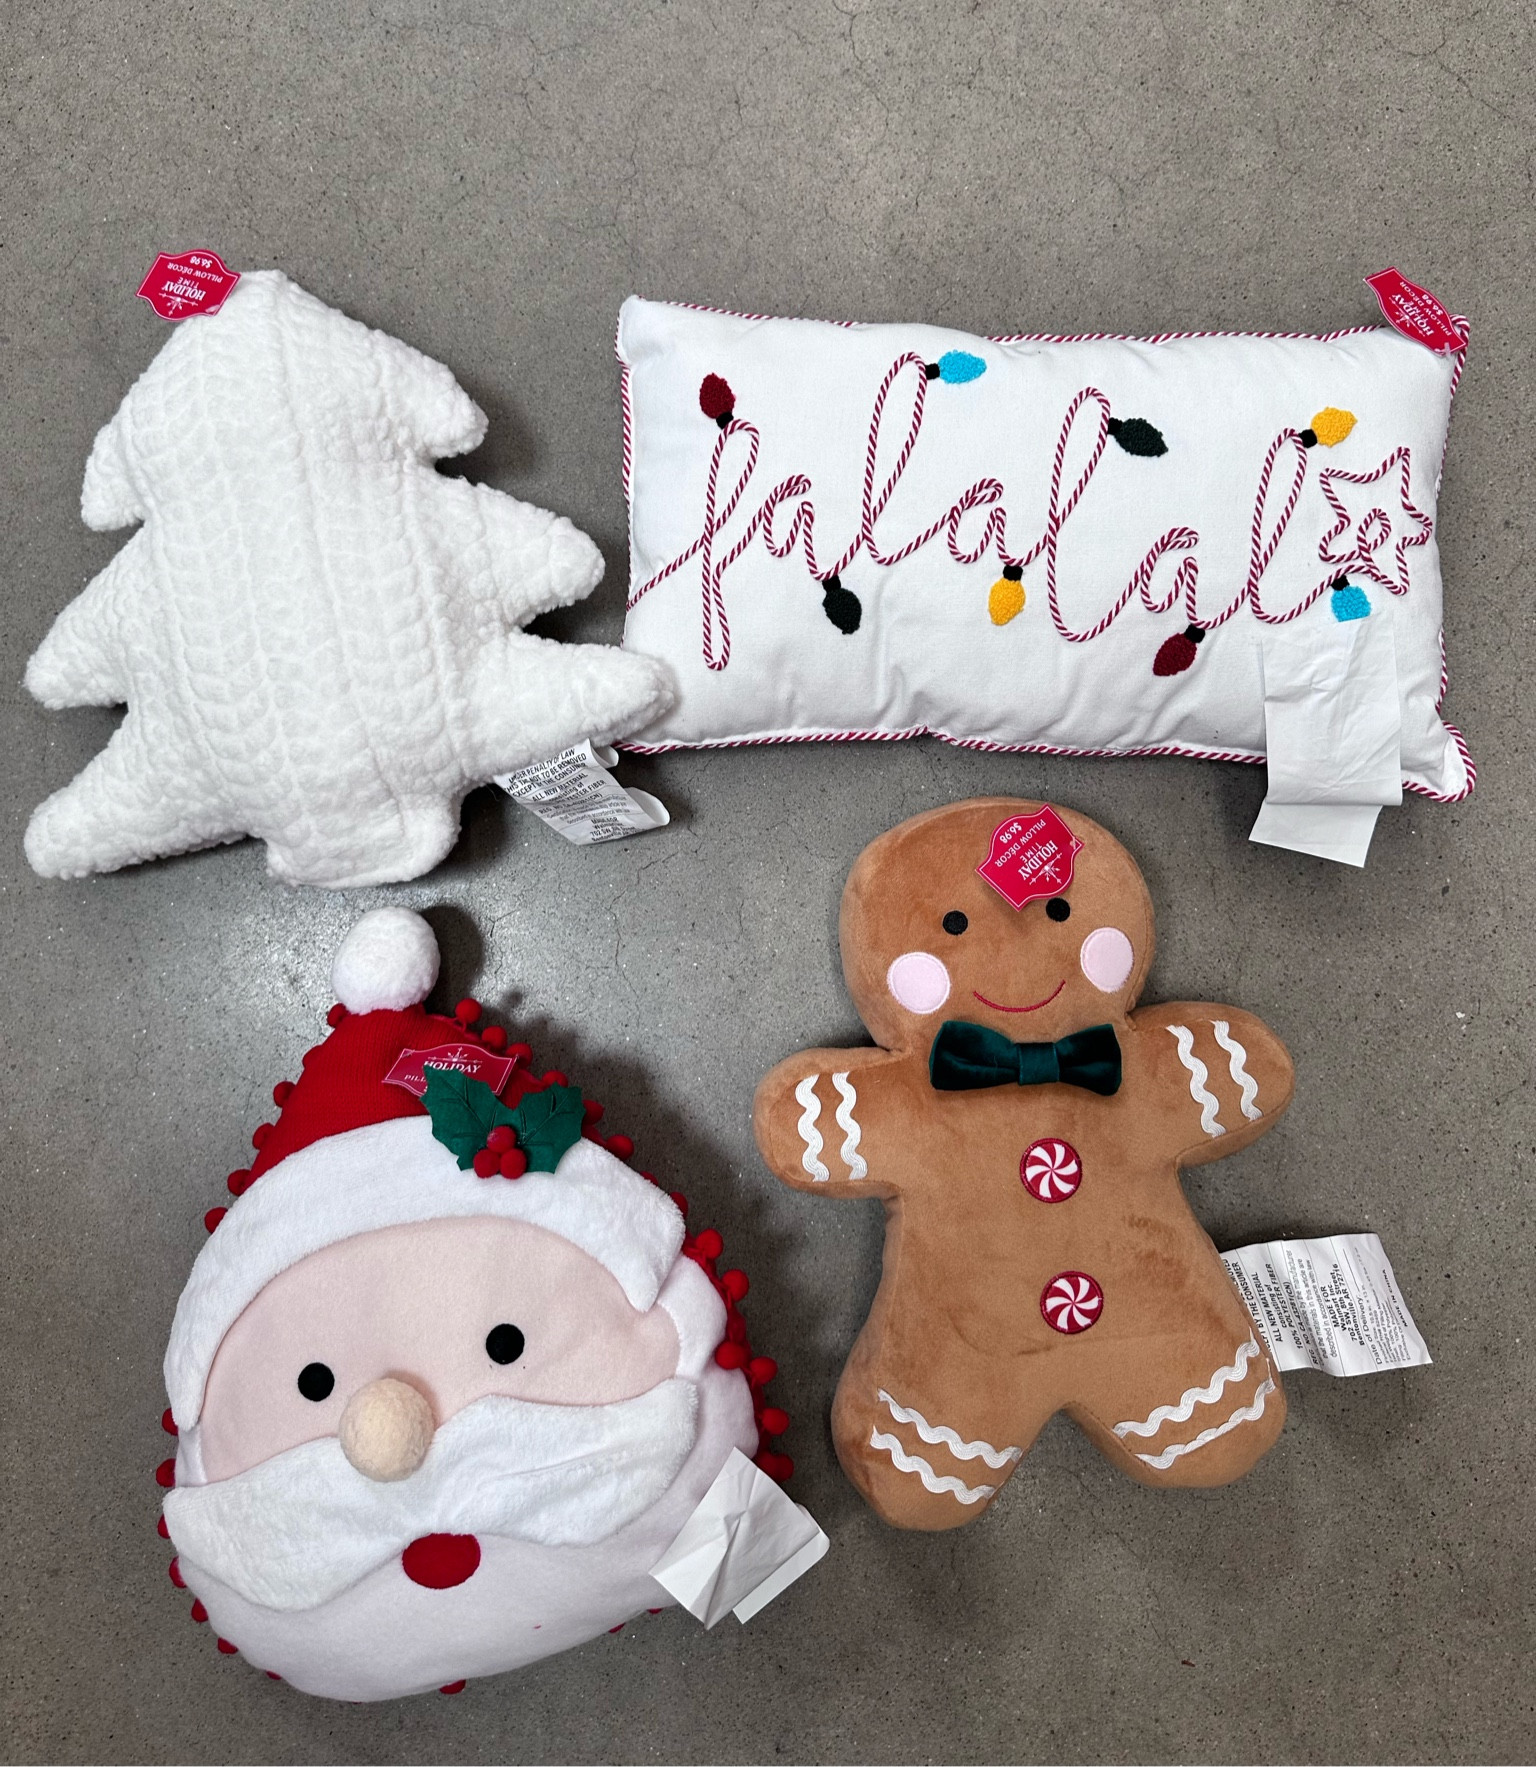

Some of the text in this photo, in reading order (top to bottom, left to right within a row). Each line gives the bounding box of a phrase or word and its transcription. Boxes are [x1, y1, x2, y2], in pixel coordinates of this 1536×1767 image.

[190, 256, 212, 268] $6.98
[177, 276, 199, 288] TIME
[193, 270, 223, 283] PILLOW
[161, 281, 206, 300] HOLIDAY
[1392, 294, 1434, 335] HOLIDAY
[1408, 300, 1428, 322] TIME
[1422, 294, 1443, 315] $6.98
[1423, 307, 1452, 336] PILLOW
[526, 758, 553, 775] PENALTY
[560, 748, 575, 760] LAW
[529, 774, 541, 783] NOT
[541, 770, 550, 779] TO
[549, 766, 559, 775] BE
[557, 753, 586, 770] REMOVED
[532, 773, 588, 802] ALL NEW MATERIAL
[542, 777, 555, 785] THE
[587, 779, 605, 791] FIBER
[994, 819, 1046, 867] PILLOW DÉCOR
[999, 822, 1022, 843] $6.98
[1018, 840, 1057, 880] HOLIDAY
[1019, 842, 1042, 863] TIME
[1286, 1250, 1300, 1289] manufacturer
[1332, 1263, 1345, 1286] 72716
[1382, 1269, 1392, 1293] CHINA
[1231, 1262, 1254, 1301] CONSUMER
[1263, 1284, 1287, 1328] consisting of
[1265, 1263, 1303, 1349] 100% POLYESTER FIBER
[1295, 1290, 1303, 1300] the
[1312, 1284, 1328, 1319] accordance
[1320, 1285, 1340, 1327] MADE FOR
[1327, 1282, 1347, 1331] Walmart Inc.
[1391, 1295, 1397, 1303] IN
[1248, 1301, 1259, 1316] THE
[1251, 1272, 1283, 1342] ALL NEW MATERIAL
[1395, 1306, 1408, 1327] MADE
[1323, 1327, 1337, 1358] described
[1347, 1327, 1357, 1341] 702
[1365, 1333, 1373, 1342] of
[1370, 1344, 1382, 1365] Date
